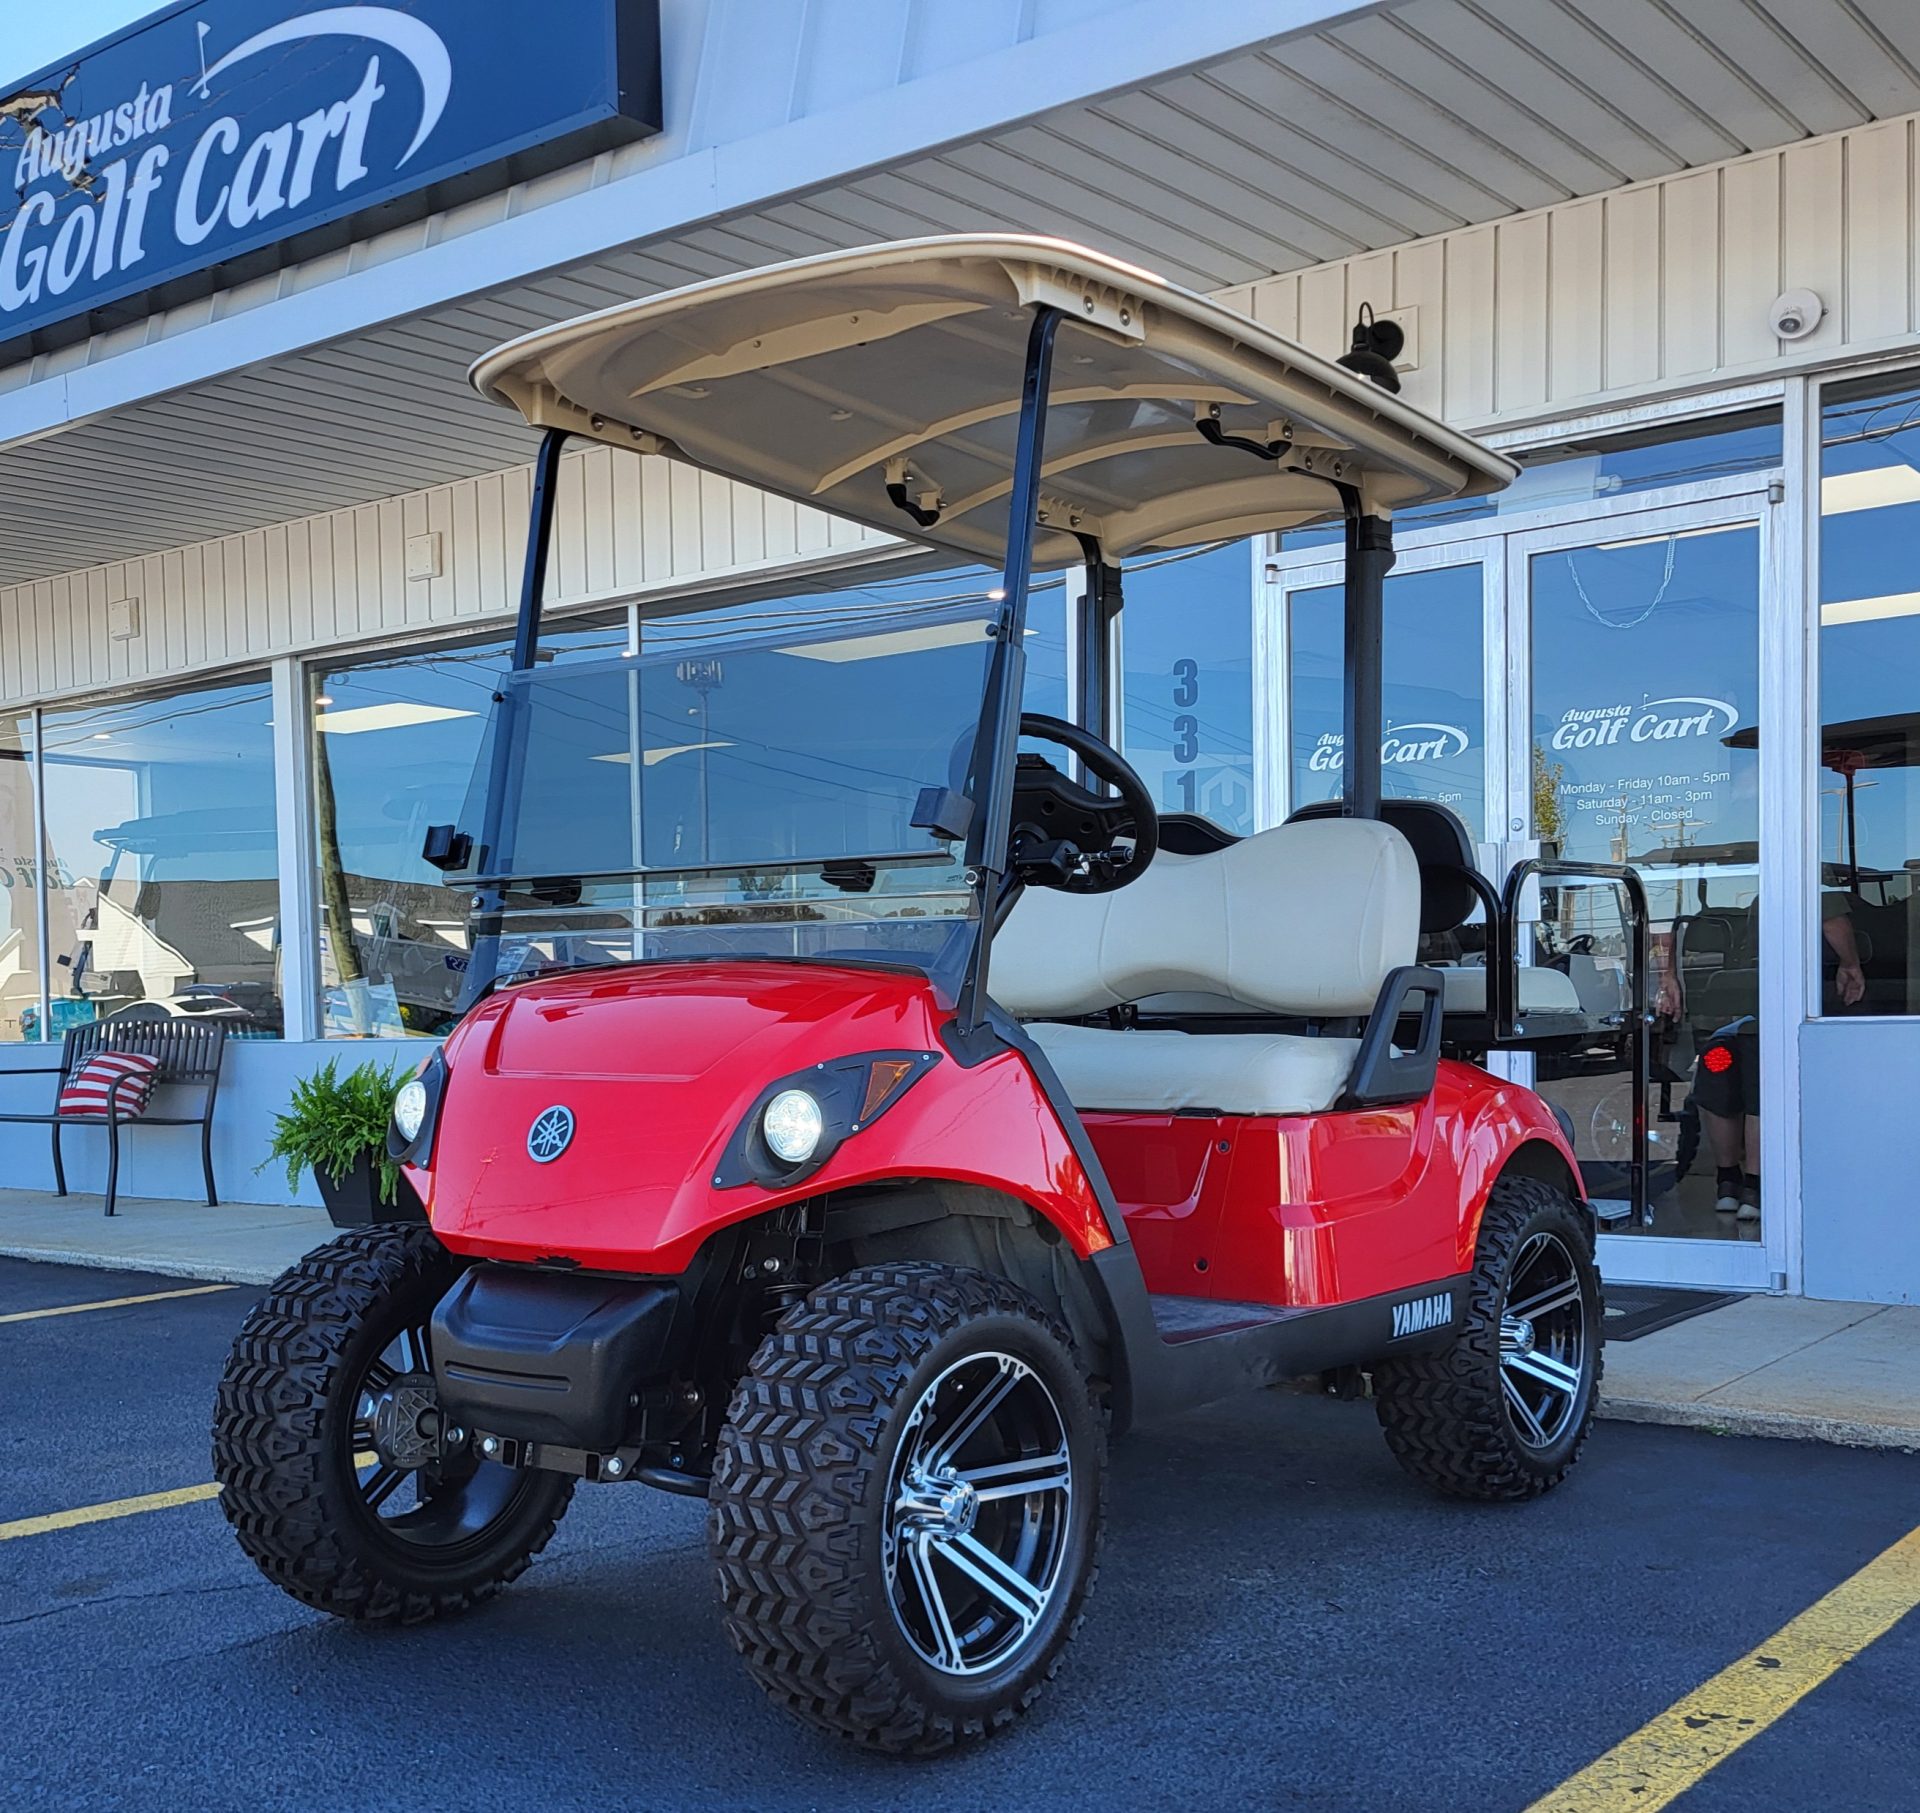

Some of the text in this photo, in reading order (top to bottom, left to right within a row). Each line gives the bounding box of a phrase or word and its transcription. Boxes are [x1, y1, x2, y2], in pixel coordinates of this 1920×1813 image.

[14, 81, 173, 189] Augusta
[0, 55, 385, 312] Golf Cart
[1561, 704, 1632, 723] Augusta
[1552, 708, 1715, 750] Golf Cart
[1309, 734, 1448, 771] Go Cart
[1438, 792, 1462, 803] 5pm
[1560, 782, 1606, 796] Monday
[1617, 777, 1653, 790] Friday
[1658, 774, 1690, 787] 10am
[1702, 772, 1730, 785] 5pm
[1576, 796, 1628, 811] Saturday
[1641, 793, 1673, 805] 11am
[1685, 790, 1712, 803] 3pm
[1596, 813, 1639, 826] Sunday
[1651, 808, 1693, 822] Closed
[1392, 1292, 1452, 1338] YAMAHA
